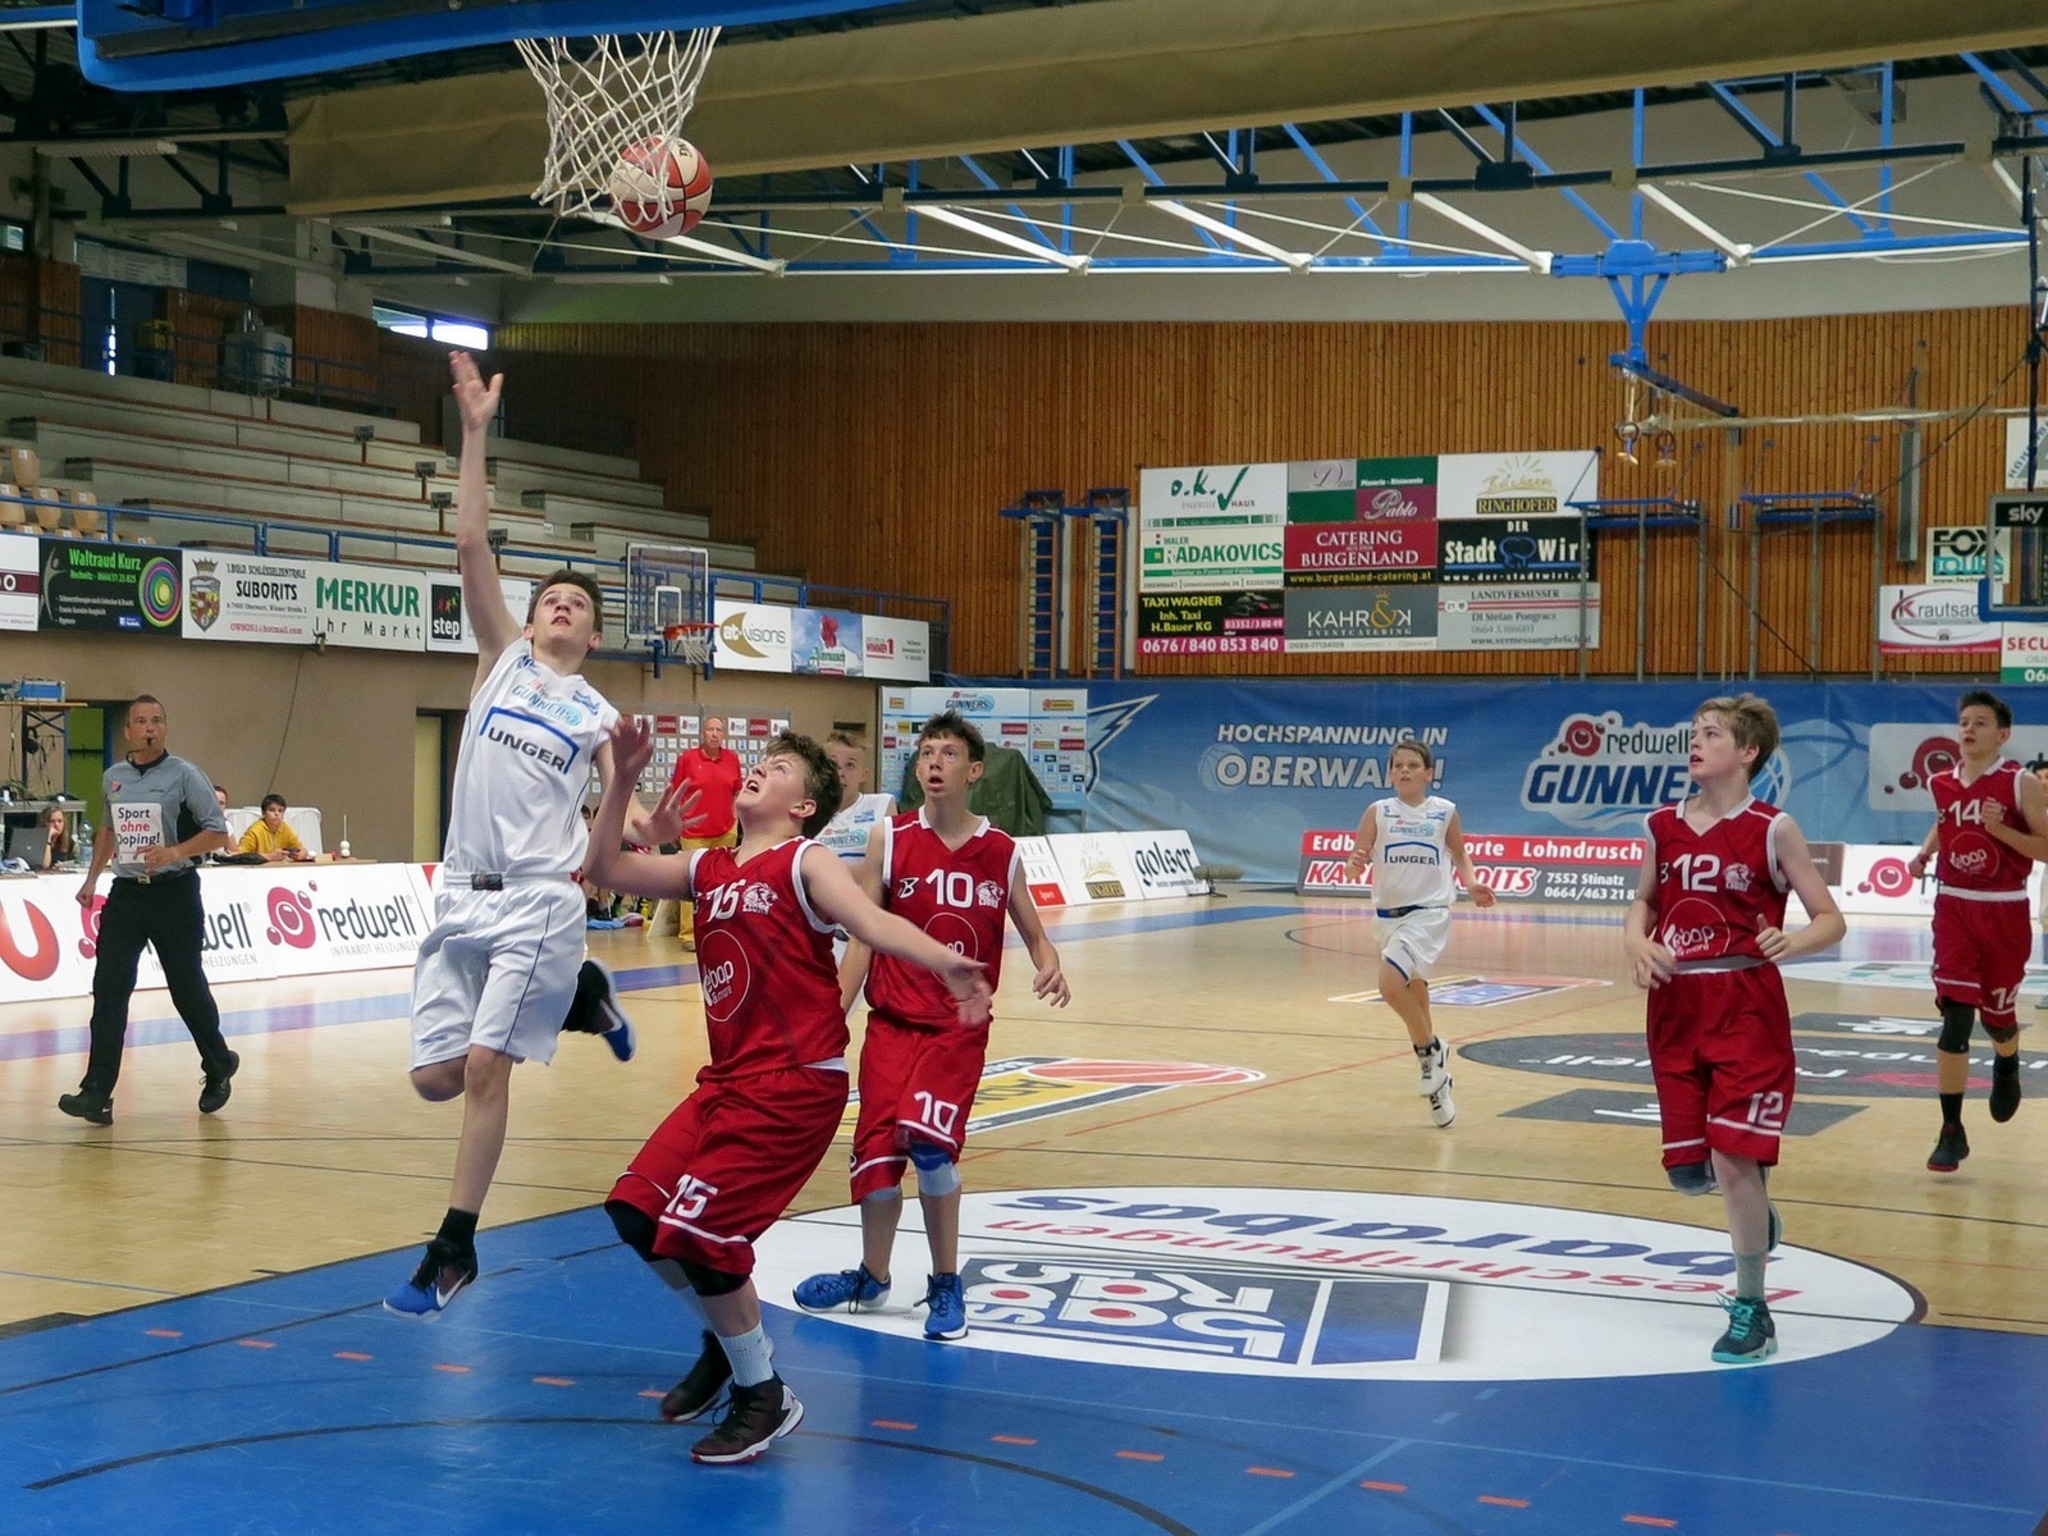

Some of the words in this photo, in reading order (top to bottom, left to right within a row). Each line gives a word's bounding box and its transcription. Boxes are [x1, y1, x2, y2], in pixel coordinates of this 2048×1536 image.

[1231, 499, 1255, 508] HAUS
[1363, 488, 1418, 520] Pablo
[1478, 498, 1557, 513] RINGHOFER
[2008, 504, 2044, 524] sky
[1506, 520, 1529, 532] DER
[1163, 537, 1190, 545] MALER
[1316, 530, 1403, 547] CATERING
[1444, 537, 1497, 563] Stadt
[69, 547, 117, 568] Waltraud
[117, 553, 142, 571] Kurz
[1301, 549, 1419, 567] BURGENLAND
[236, 580, 298, 601] SUBORITS
[316, 576, 420, 618] MERKUR
[1142, 597, 1170, 608] TAXI
[1170, 596, 1223, 607] WAGNER
[1470, 589, 1560, 600] LANDVERMESSER
[1159, 610, 1179, 620] Inh.
[1180, 609, 1202, 620] Taxi
[1195, 621, 1213, 631] KG
[315, 616, 346, 633] Ihr
[363, 620, 421, 640] Markt
[433, 614, 460, 639] step
[1142, 639, 1179, 653] 0676
[1188, 639, 1217, 652] 840
[1219, 638, 1247, 651] 853
[1250, 637, 1279, 651] 840
[1217, 723, 1415, 745] HOCHSPANNUNG
[1421, 726, 1448, 746] IN
[1606, 728, 1691, 756] redwell
[488, 726, 566, 773] UNGER
[1214, 754, 1446, 790] OBERWA!
[1527, 763, 1699, 806] GUNNE
[118, 807, 150, 822] Sport
[1948, 798, 1983, 827] 14
[120, 821, 150, 833] ohne
[1389, 855, 1436, 866] UNGER
[1523, 841, 1643, 860] Lohndrusch
[1134, 841, 1194, 887] golser
[1672, 852, 1722, 893] 12
[924, 868, 974, 909] 10
[1546, 872, 1577, 885] 7552
[1580, 872, 1625, 887] Stinatz
[706, 878, 747, 923] 15
[1544, 886, 1608, 902] 0664/463
[317, 895, 417, 942] redwell
[331, 943, 373, 957] INFRAROT
[914, 1090, 960, 1137] 10
[1746, 1090, 1784, 1129] 12
[664, 1173, 719, 1220] 15
[989, 1195, 1786, 1277] barabas
[984, 1218, 1802, 1304] beschriftungen
